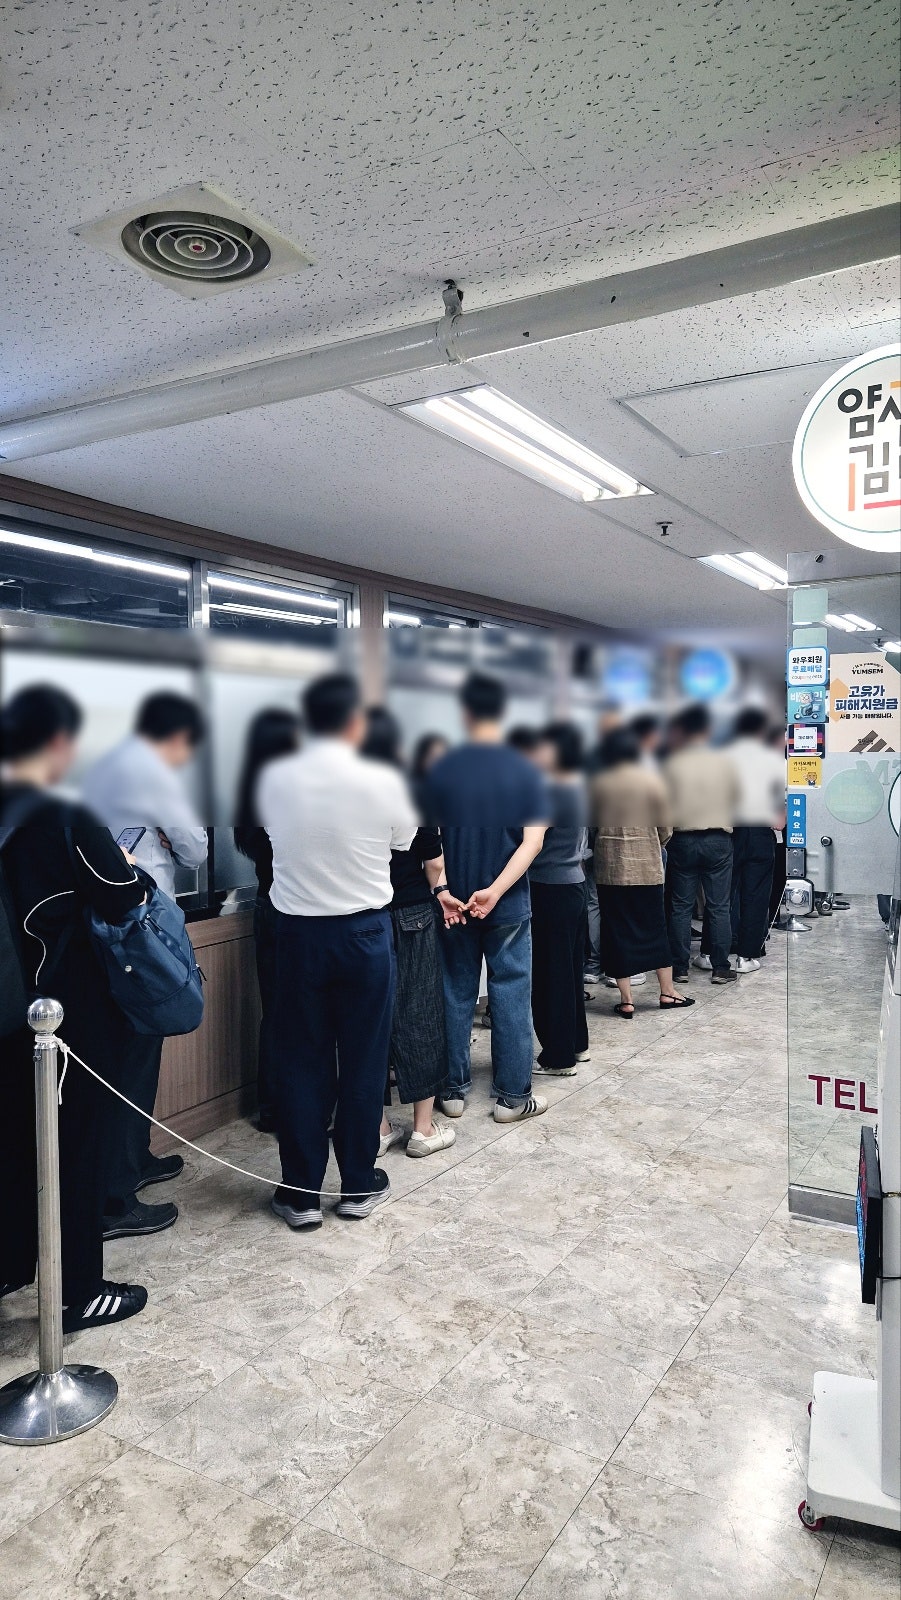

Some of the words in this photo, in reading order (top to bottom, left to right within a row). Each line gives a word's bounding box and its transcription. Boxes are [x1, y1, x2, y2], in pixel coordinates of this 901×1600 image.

[792, 656, 822, 664] 와우회원
[792, 665, 822, 673] 무료배달
[848, 685, 886, 698] 고유가
[835, 698, 899, 710] 피해지원금
[793, 799, 801, 829] 미세요
[808, 1074, 878, 1114] TEL
